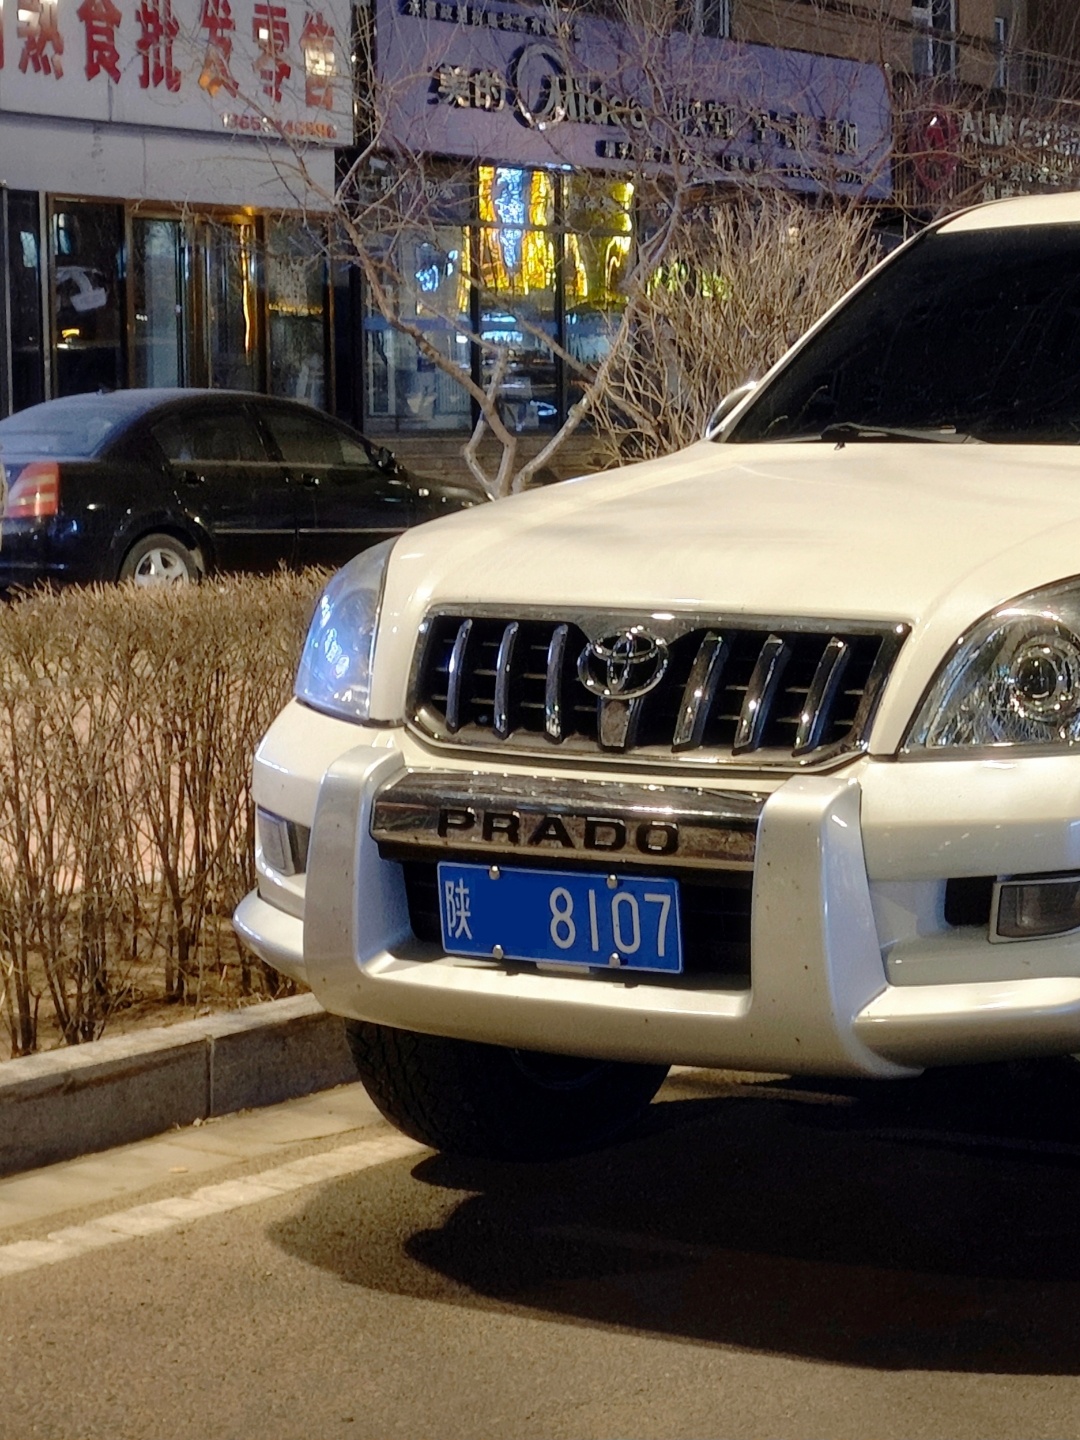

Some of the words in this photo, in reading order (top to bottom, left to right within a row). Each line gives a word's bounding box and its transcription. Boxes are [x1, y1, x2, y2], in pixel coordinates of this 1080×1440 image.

[0, 0, 336, 110] 熟食批发零售
[437, 807, 680, 856] PRADO
[549, 886, 672, 958] 8107
